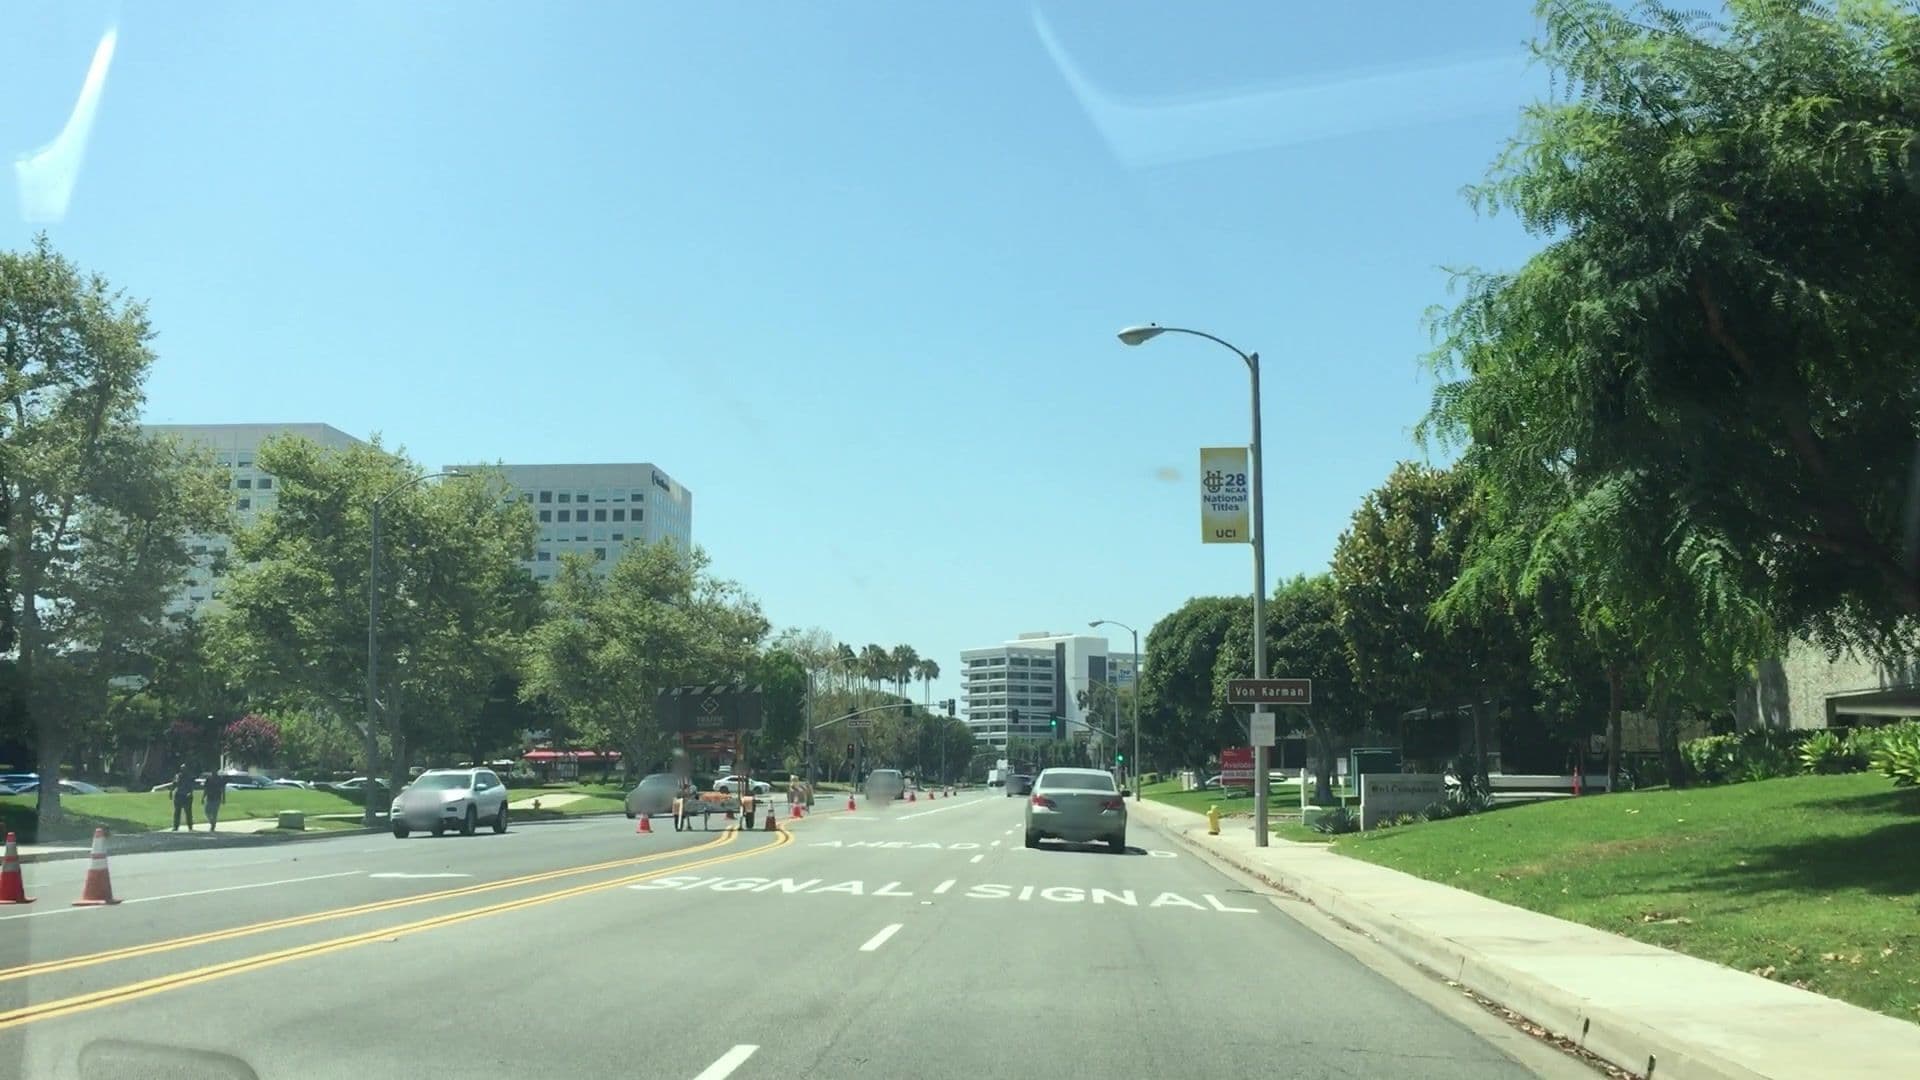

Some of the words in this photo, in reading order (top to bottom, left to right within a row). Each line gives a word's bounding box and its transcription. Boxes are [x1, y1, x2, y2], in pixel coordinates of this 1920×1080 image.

[1225, 473, 1247, 487] 28
[1203, 494, 1247, 503] National
[1212, 503, 1241, 511] Titles
[1216, 529, 1237, 538] UCI
[1235, 687, 1256, 697] Von
[1262, 687, 1304, 697] Karman
[808, 840, 981, 850] AHEAD
[628, 876, 914, 897] SIGNAL
[965, 884, 1259, 914] SIGNAL
